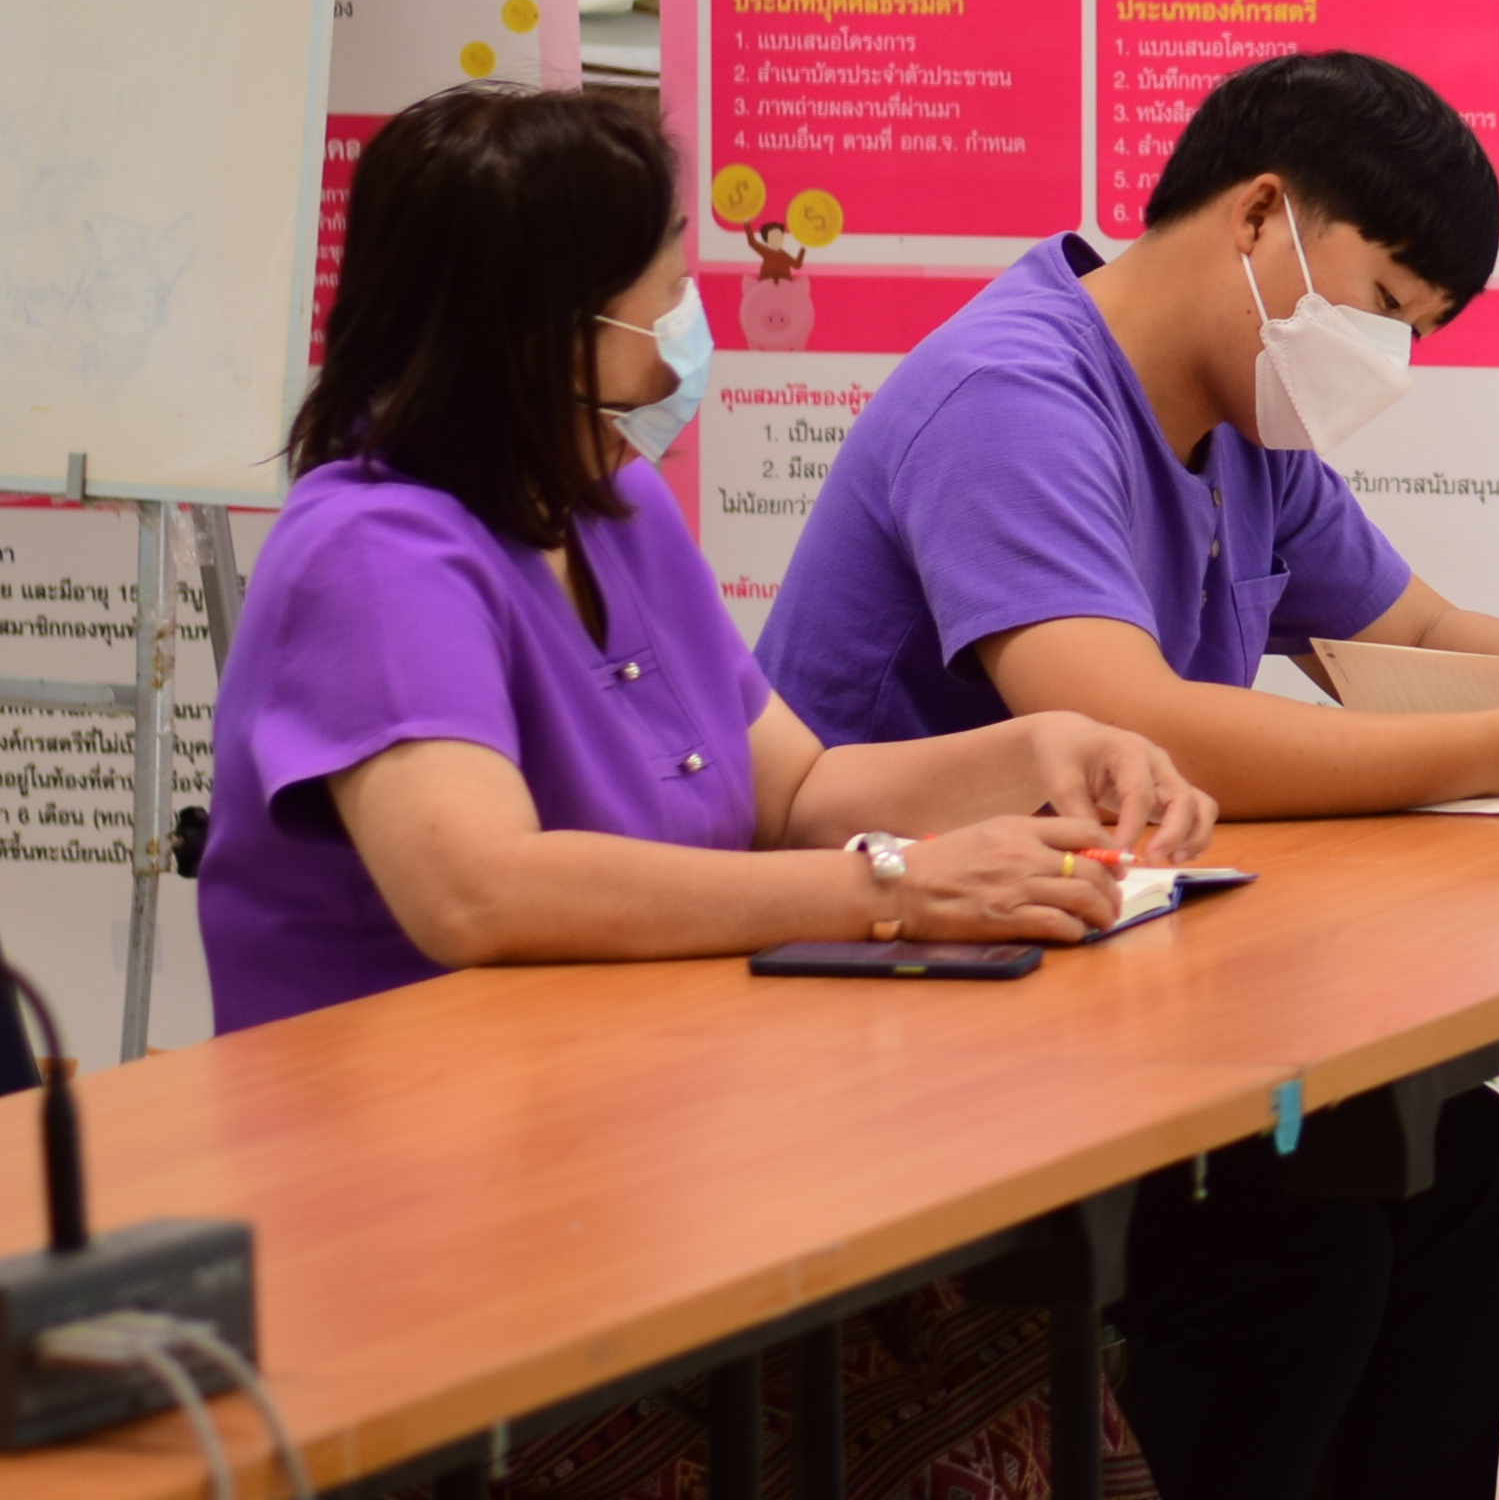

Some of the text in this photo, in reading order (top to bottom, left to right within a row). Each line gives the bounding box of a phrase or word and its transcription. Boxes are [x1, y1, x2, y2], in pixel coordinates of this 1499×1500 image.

[758, 26, 916, 52] แบบเสนอโครงการ
[1138, 32, 1298, 58] แบบเสนอโครงการ
[758, 61, 1012, 86] สำเนาบัตรประจำตัวประชาชน
[757, 92, 961, 118] ภาพถ่ายผลงานที่ผ่านมา
[758, 124, 1026, 153] แบบอื่นๆ ตามที่ กำหนด
[19, 807, 29, 824] 6
